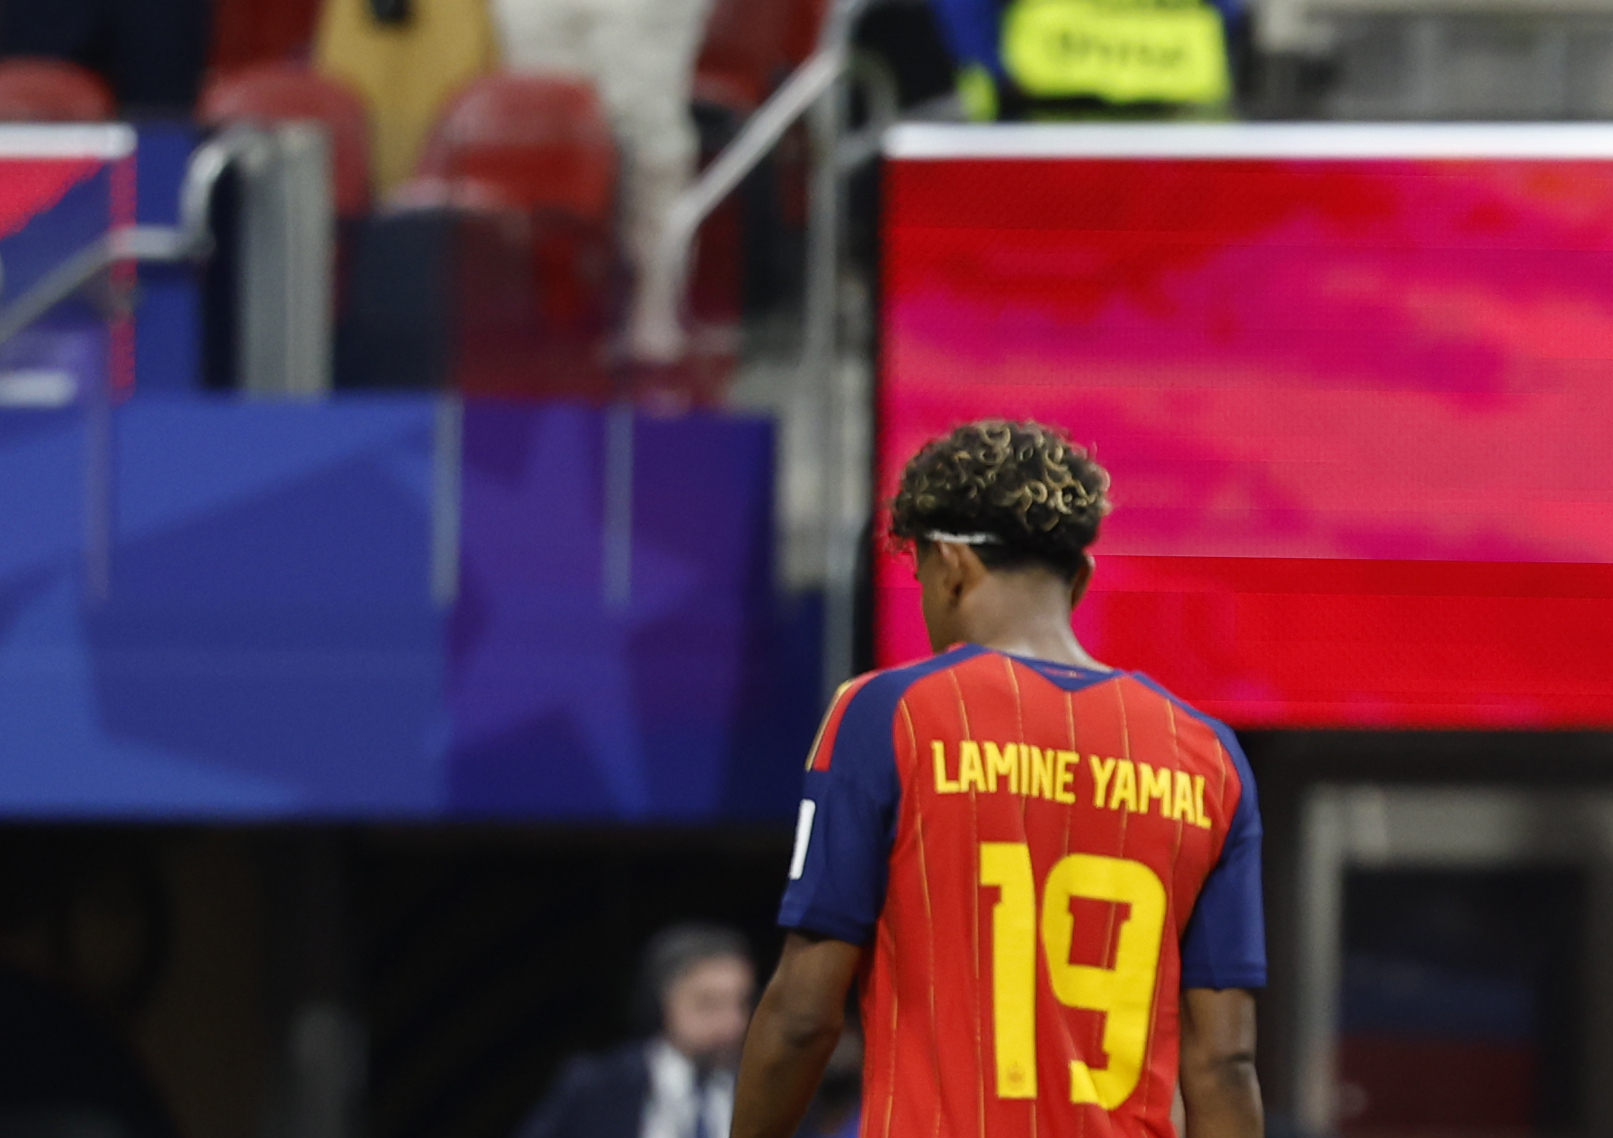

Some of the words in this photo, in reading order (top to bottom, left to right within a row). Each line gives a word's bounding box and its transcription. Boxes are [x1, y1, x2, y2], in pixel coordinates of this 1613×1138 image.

[931, 740, 1079, 803] LAMINE
[1089, 755, 1211, 829] YAMAL
[979, 842, 1167, 1111] 19
